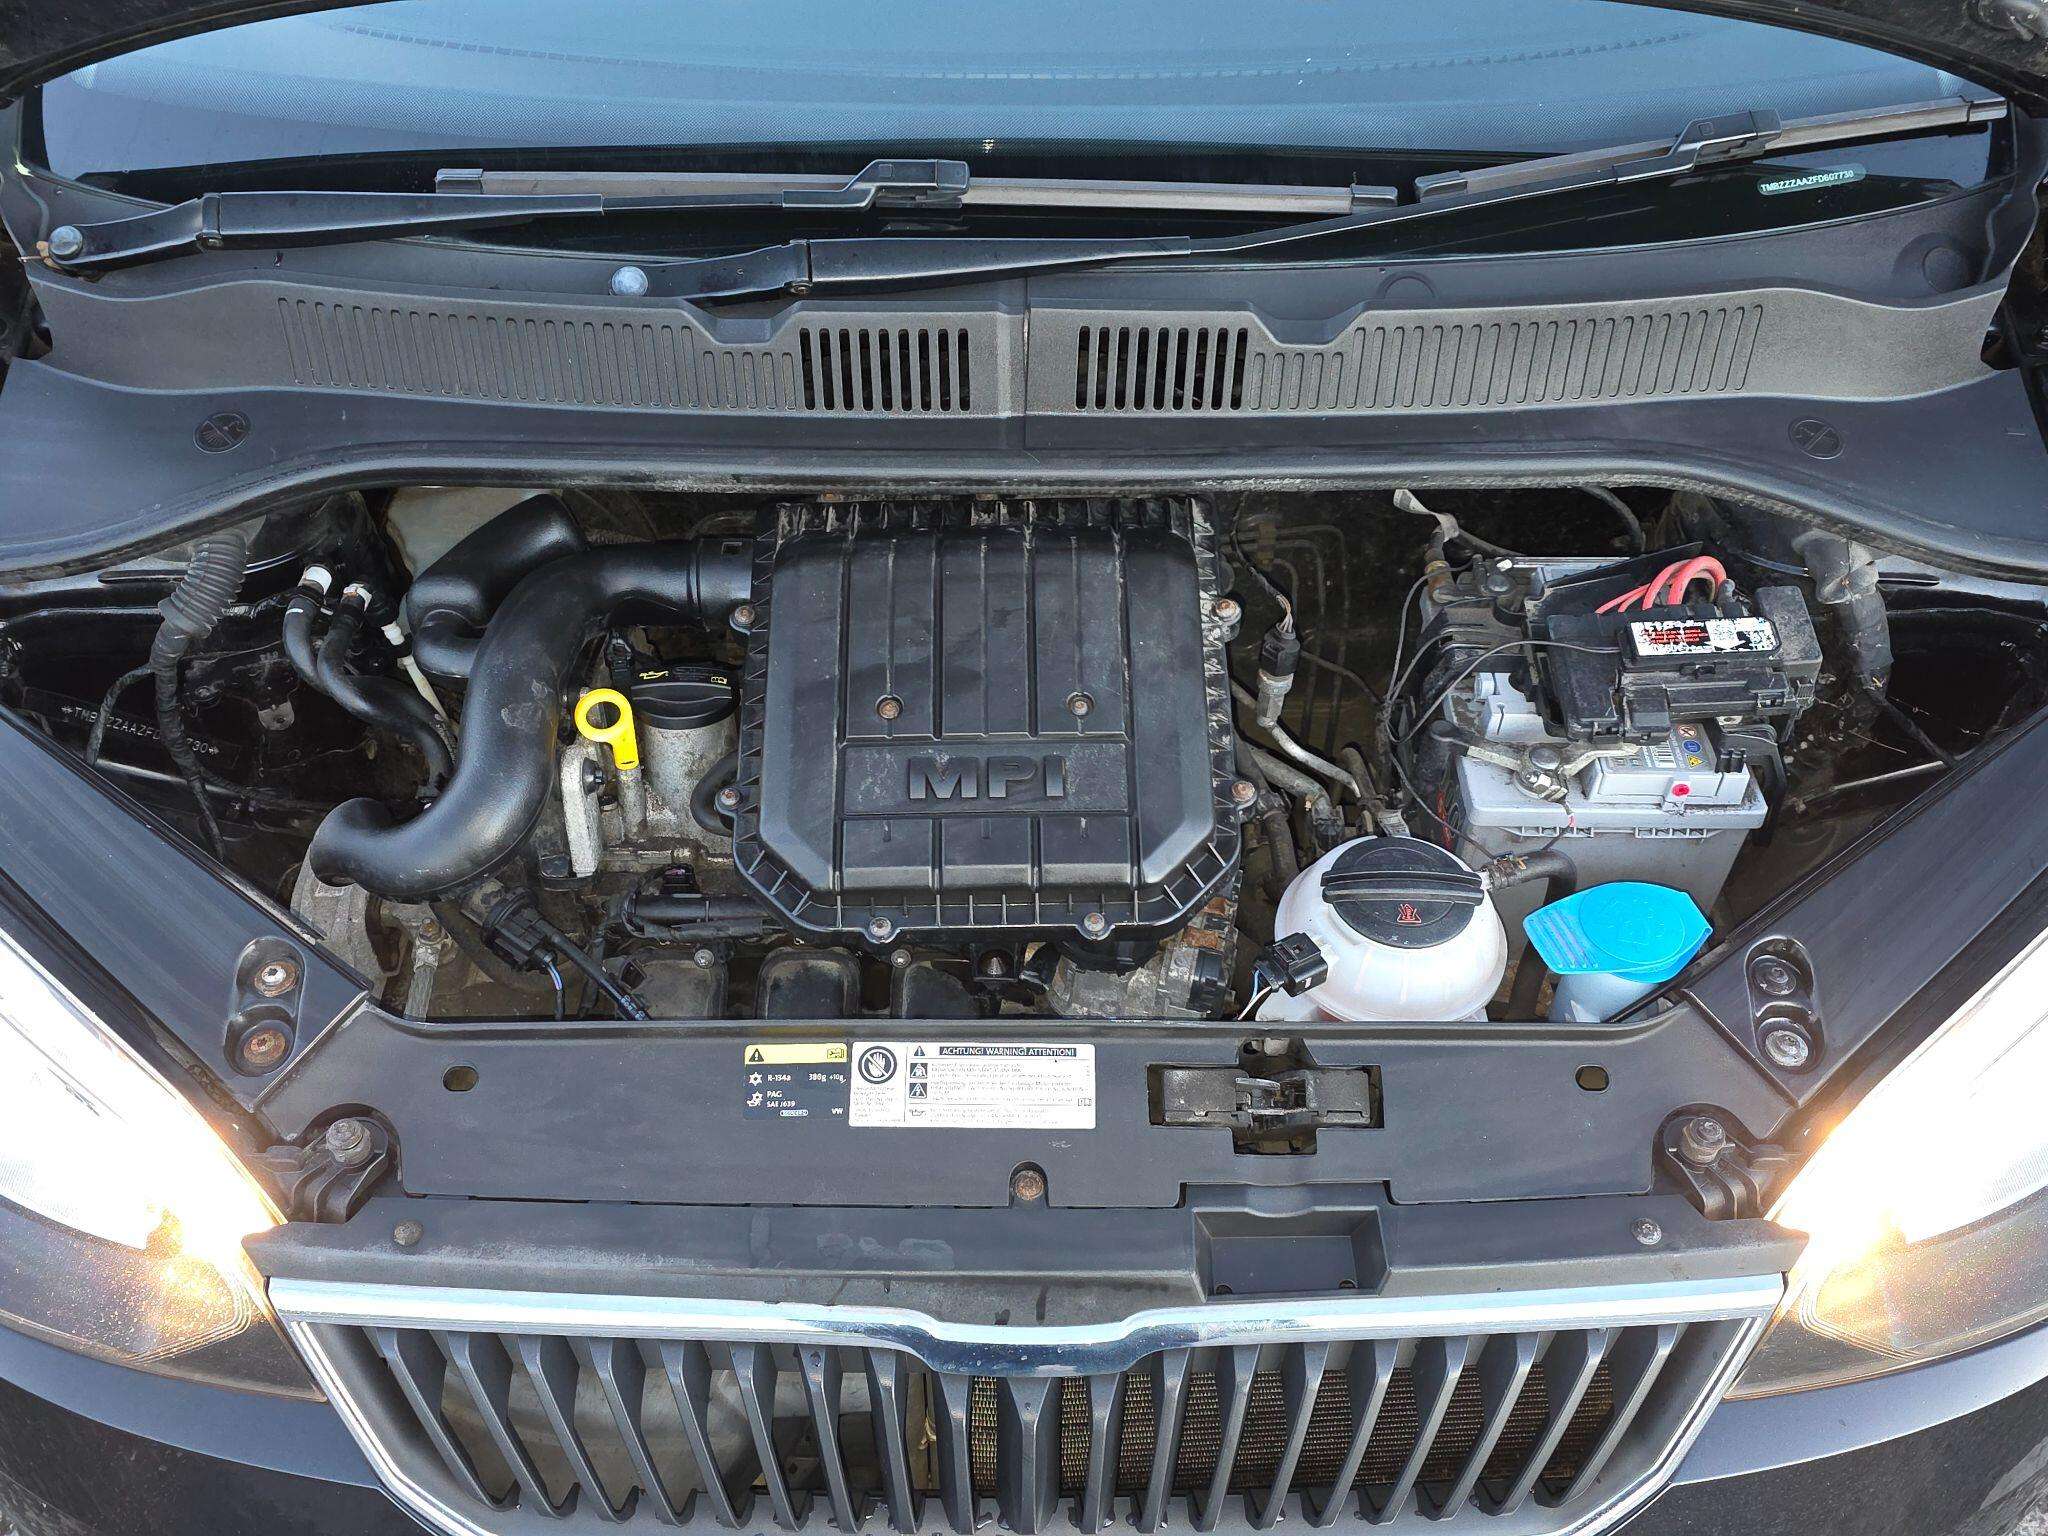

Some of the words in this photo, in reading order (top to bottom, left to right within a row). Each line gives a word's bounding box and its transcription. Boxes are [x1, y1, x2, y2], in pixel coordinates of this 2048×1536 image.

[908, 756, 1067, 799] MPI
[942, 1047, 984, 1055] ACHTUNG!
[986, 1047, 1027, 1055] WARNING!
[1029, 1048, 1075, 1057] ATTENTION!
